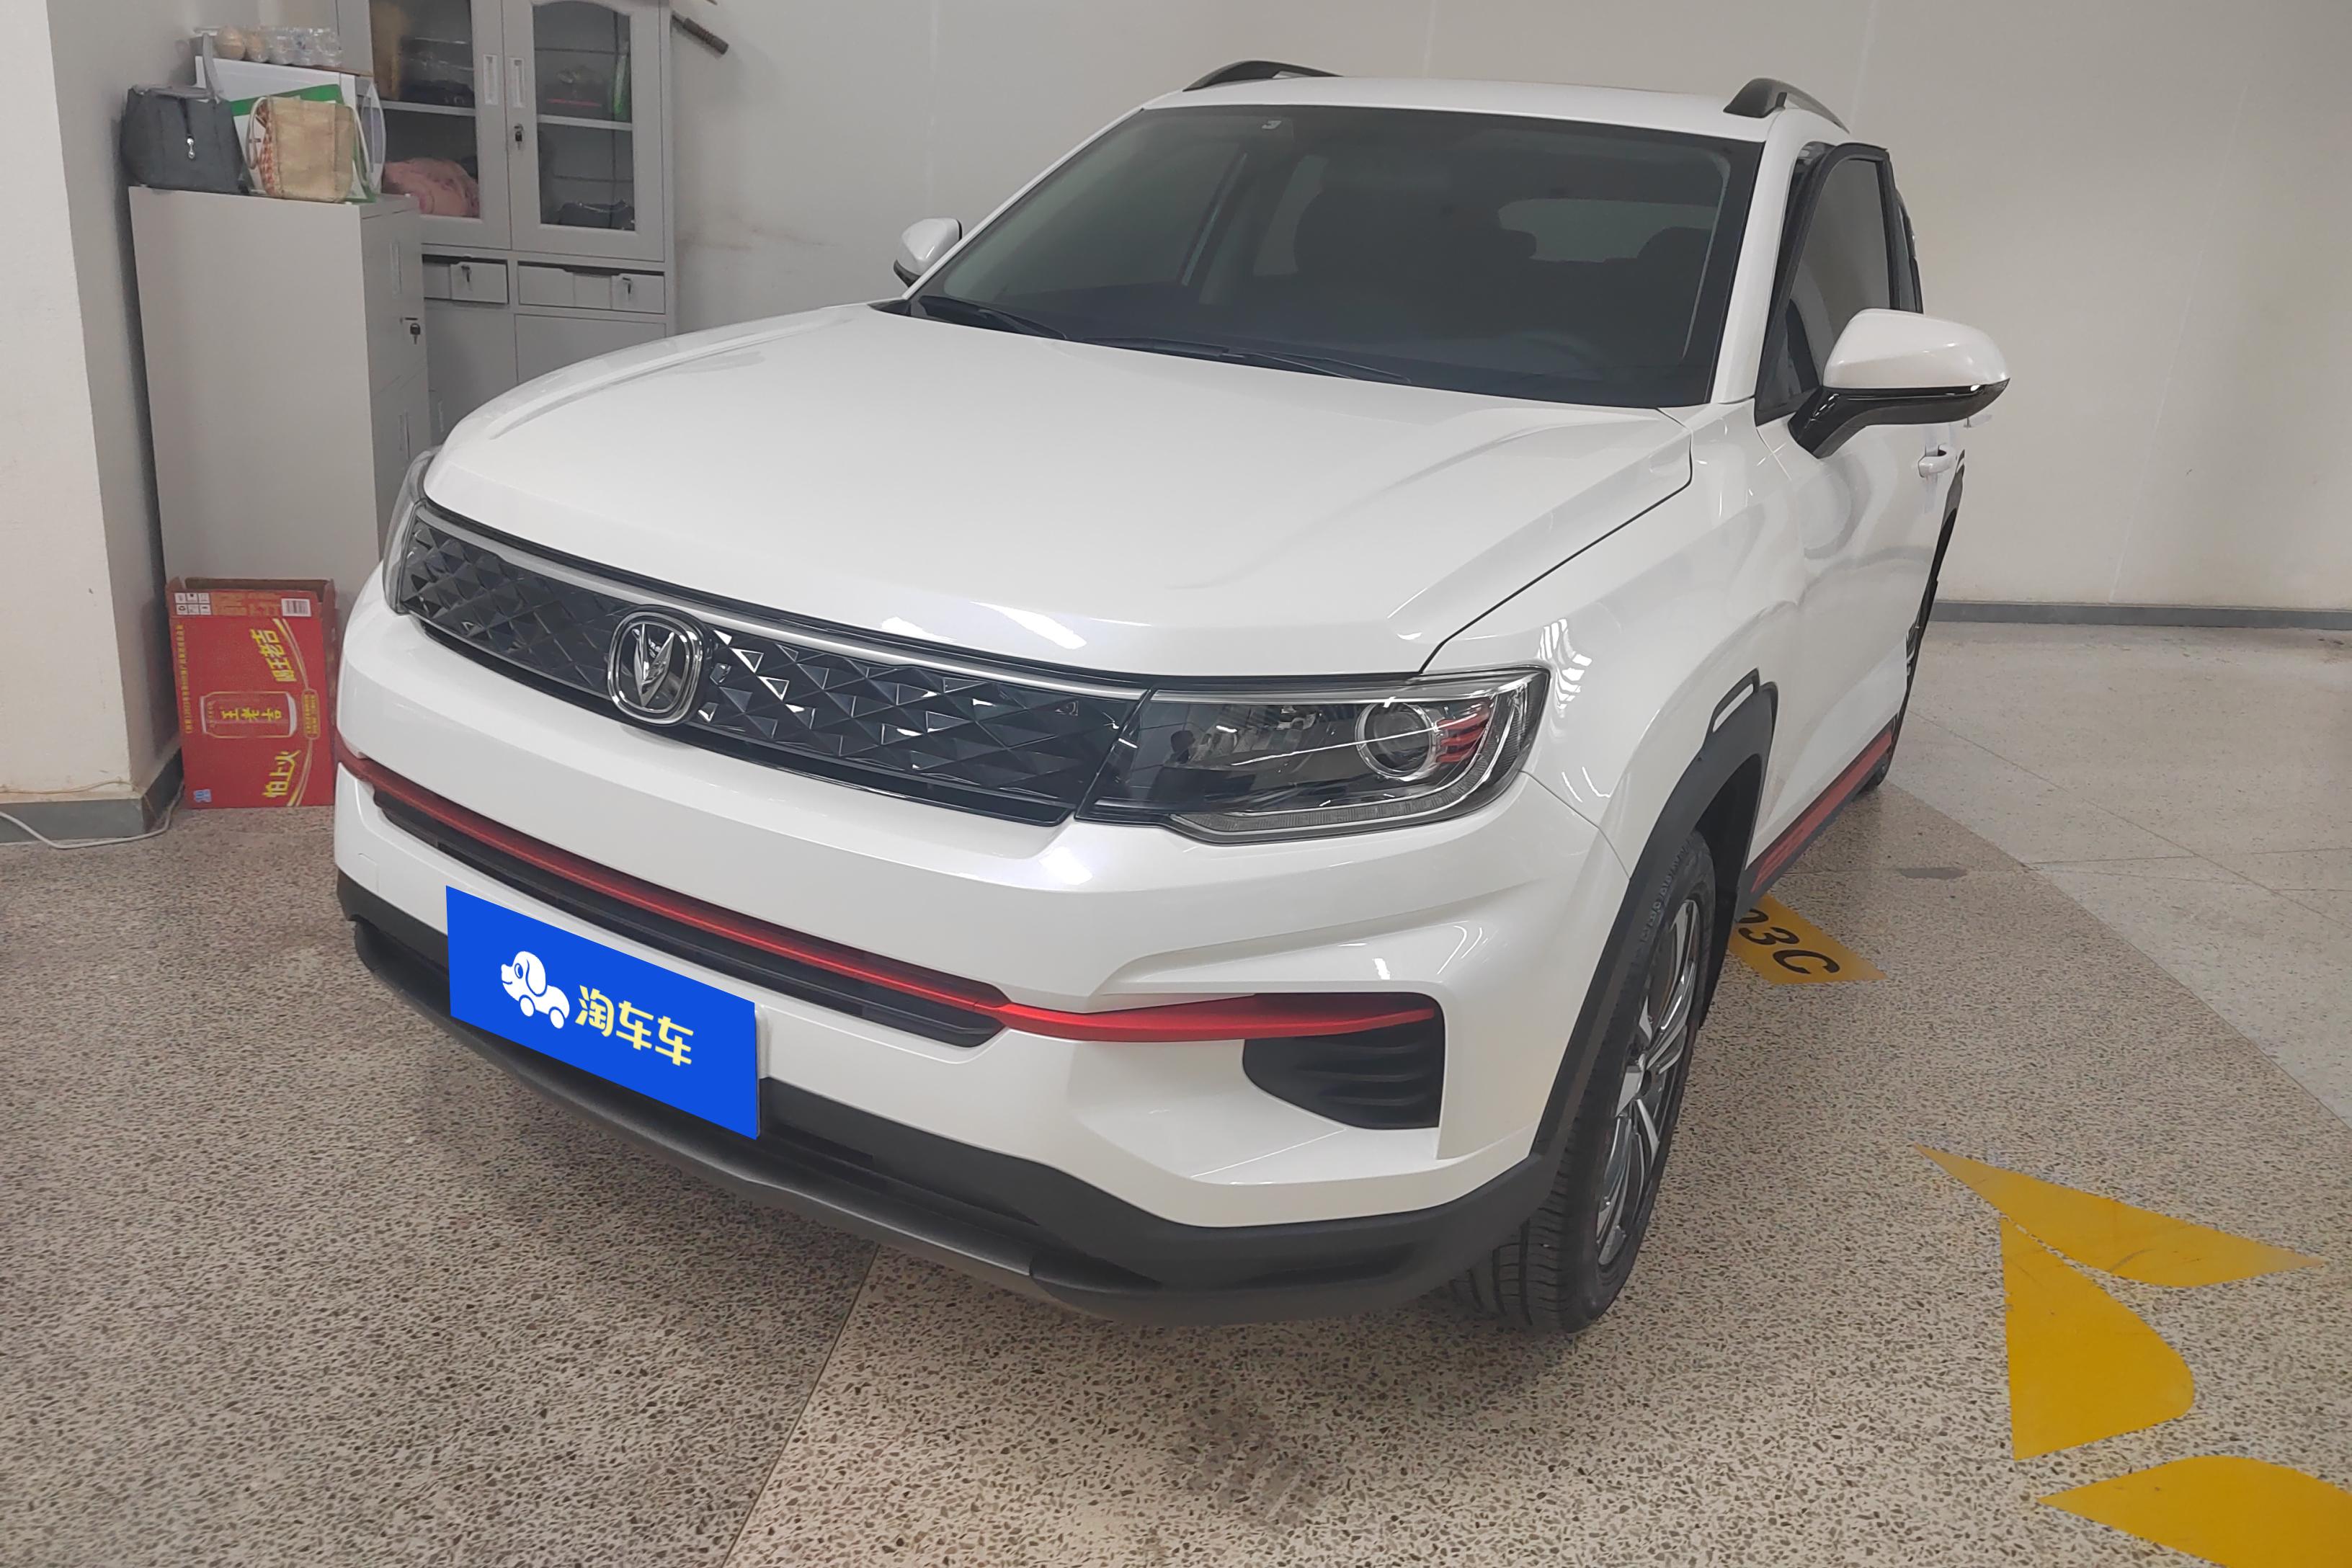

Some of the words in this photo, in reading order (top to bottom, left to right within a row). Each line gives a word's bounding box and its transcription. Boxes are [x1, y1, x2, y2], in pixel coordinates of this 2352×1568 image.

[249, 628, 297, 682] 喝王老吉
[220, 707, 282, 722] 王老吉
[262, 749, 301, 798] 怕上火
